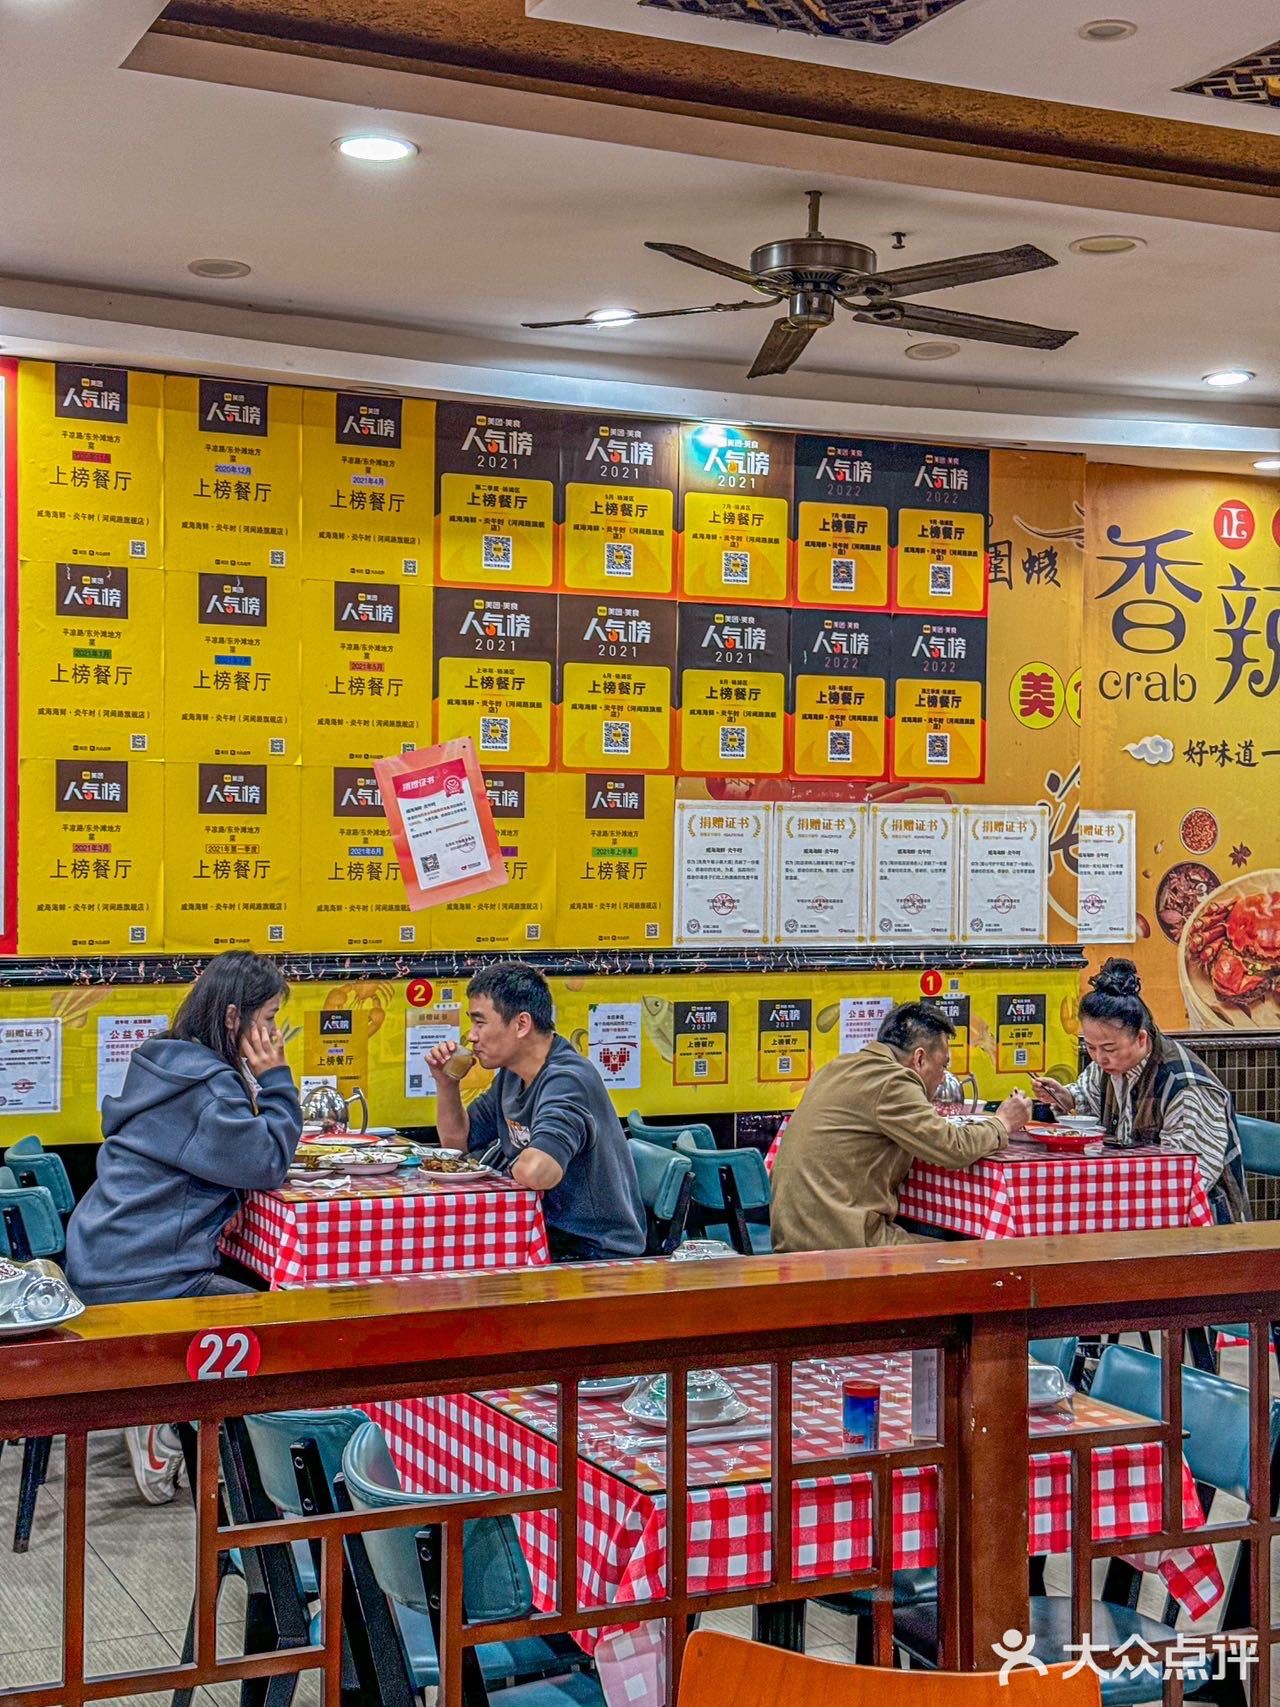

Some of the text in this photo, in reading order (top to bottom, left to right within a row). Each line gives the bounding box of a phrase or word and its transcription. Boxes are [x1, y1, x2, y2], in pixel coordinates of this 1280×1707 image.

[63, 387, 120, 411] 人气榜
[207, 403, 261, 425] 人气榜
[343, 416, 394, 438] 人气榜
[462, 427, 533, 456] 人气榜
[585, 438, 653, 466] 人气榜
[478, 455, 517, 470] 2021
[704, 448, 769, 476] 人气榜
[816, 458, 872, 483] 人气榜
[49, 466, 132, 491] 上榜餐厅
[601, 465, 639, 479] 2021
[914, 466, 968, 490] 人气榜
[194, 478, 271, 503] 上榜餐厅
[718, 476, 755, 488] 2021
[828, 484, 862, 496] 2022
[330, 490, 405, 513] 上榜餐厅
[467, 492, 527, 509] 上榜餐厅
[926, 492, 958, 504] 2022
[591, 501, 648, 518] 上榜餐厅
[708, 510, 764, 527] 上榜餐厅
[819, 518, 868, 534] 上榜餐厅
[918, 525, 965, 540] 上榜餐厅
[64, 585, 121, 609] 人气榜
[206, 594, 260, 616] 人气榜
[341, 603, 393, 624] 人气榜
[460, 611, 530, 638] 人气榜
[583, 618, 650, 643] 人气榜
[476, 639, 515, 652] 2021
[701, 625, 766, 650] 人气榜
[812, 631, 869, 655] 人气榜
[599, 645, 637, 657] 2021
[912, 634, 966, 659] 人气榜
[716, 652, 752, 664] 2021
[825, 656, 858, 669] 2022
[924, 660, 955, 673] 2022
[50, 664, 132, 686] 上榜餐厅
[194, 670, 271, 692] 上榜餐厅
[465, 675, 525, 691] 上榜餐厅
[1099, 663, 1197, 702] crab
[329, 676, 403, 697] 上榜餐厅
[588, 681, 646, 695] 上榜餐厅
[706, 686, 761, 701] 上榜餐厅
[816, 691, 864, 706] 上榜餐厅
[915, 695, 962, 709] 上榜餐厅
[64, 781, 120, 802] 人气榜
[207, 784, 260, 805] 人气榜
[486, 790, 518, 808] 气榜
[592, 792, 638, 809] 人气榜
[700, 816, 749, 829] 捐赠证书
[798, 818, 845, 831] 捐赠证书
[892, 820, 938, 831] 捐赠证书
[982, 820, 1027, 833] 捐赠证书
[50, 859, 132, 880] 上榜餐厅
[193, 859, 270, 880] 上榜餐厅
[328, 862, 400, 881] 上榜餐厅
[580, 862, 648, 880] 上榜餐厅
[926, 976, 934, 991] 1
[413, 985, 426, 1002] 2
[685, 1012, 717, 1024] 人气榜
[769, 1010, 800, 1022] 人气榜
[848, 1010, 884, 1018] 公益餐厅
[1007, 1004, 1035, 1016] 人气榜
[323, 1017, 349, 1030] 人气榜
[110, 1030, 157, 1039] 公益餐厅
[318, 1056, 354, 1066] 上榜餐厅
[198, 1332, 249, 1380] 22
